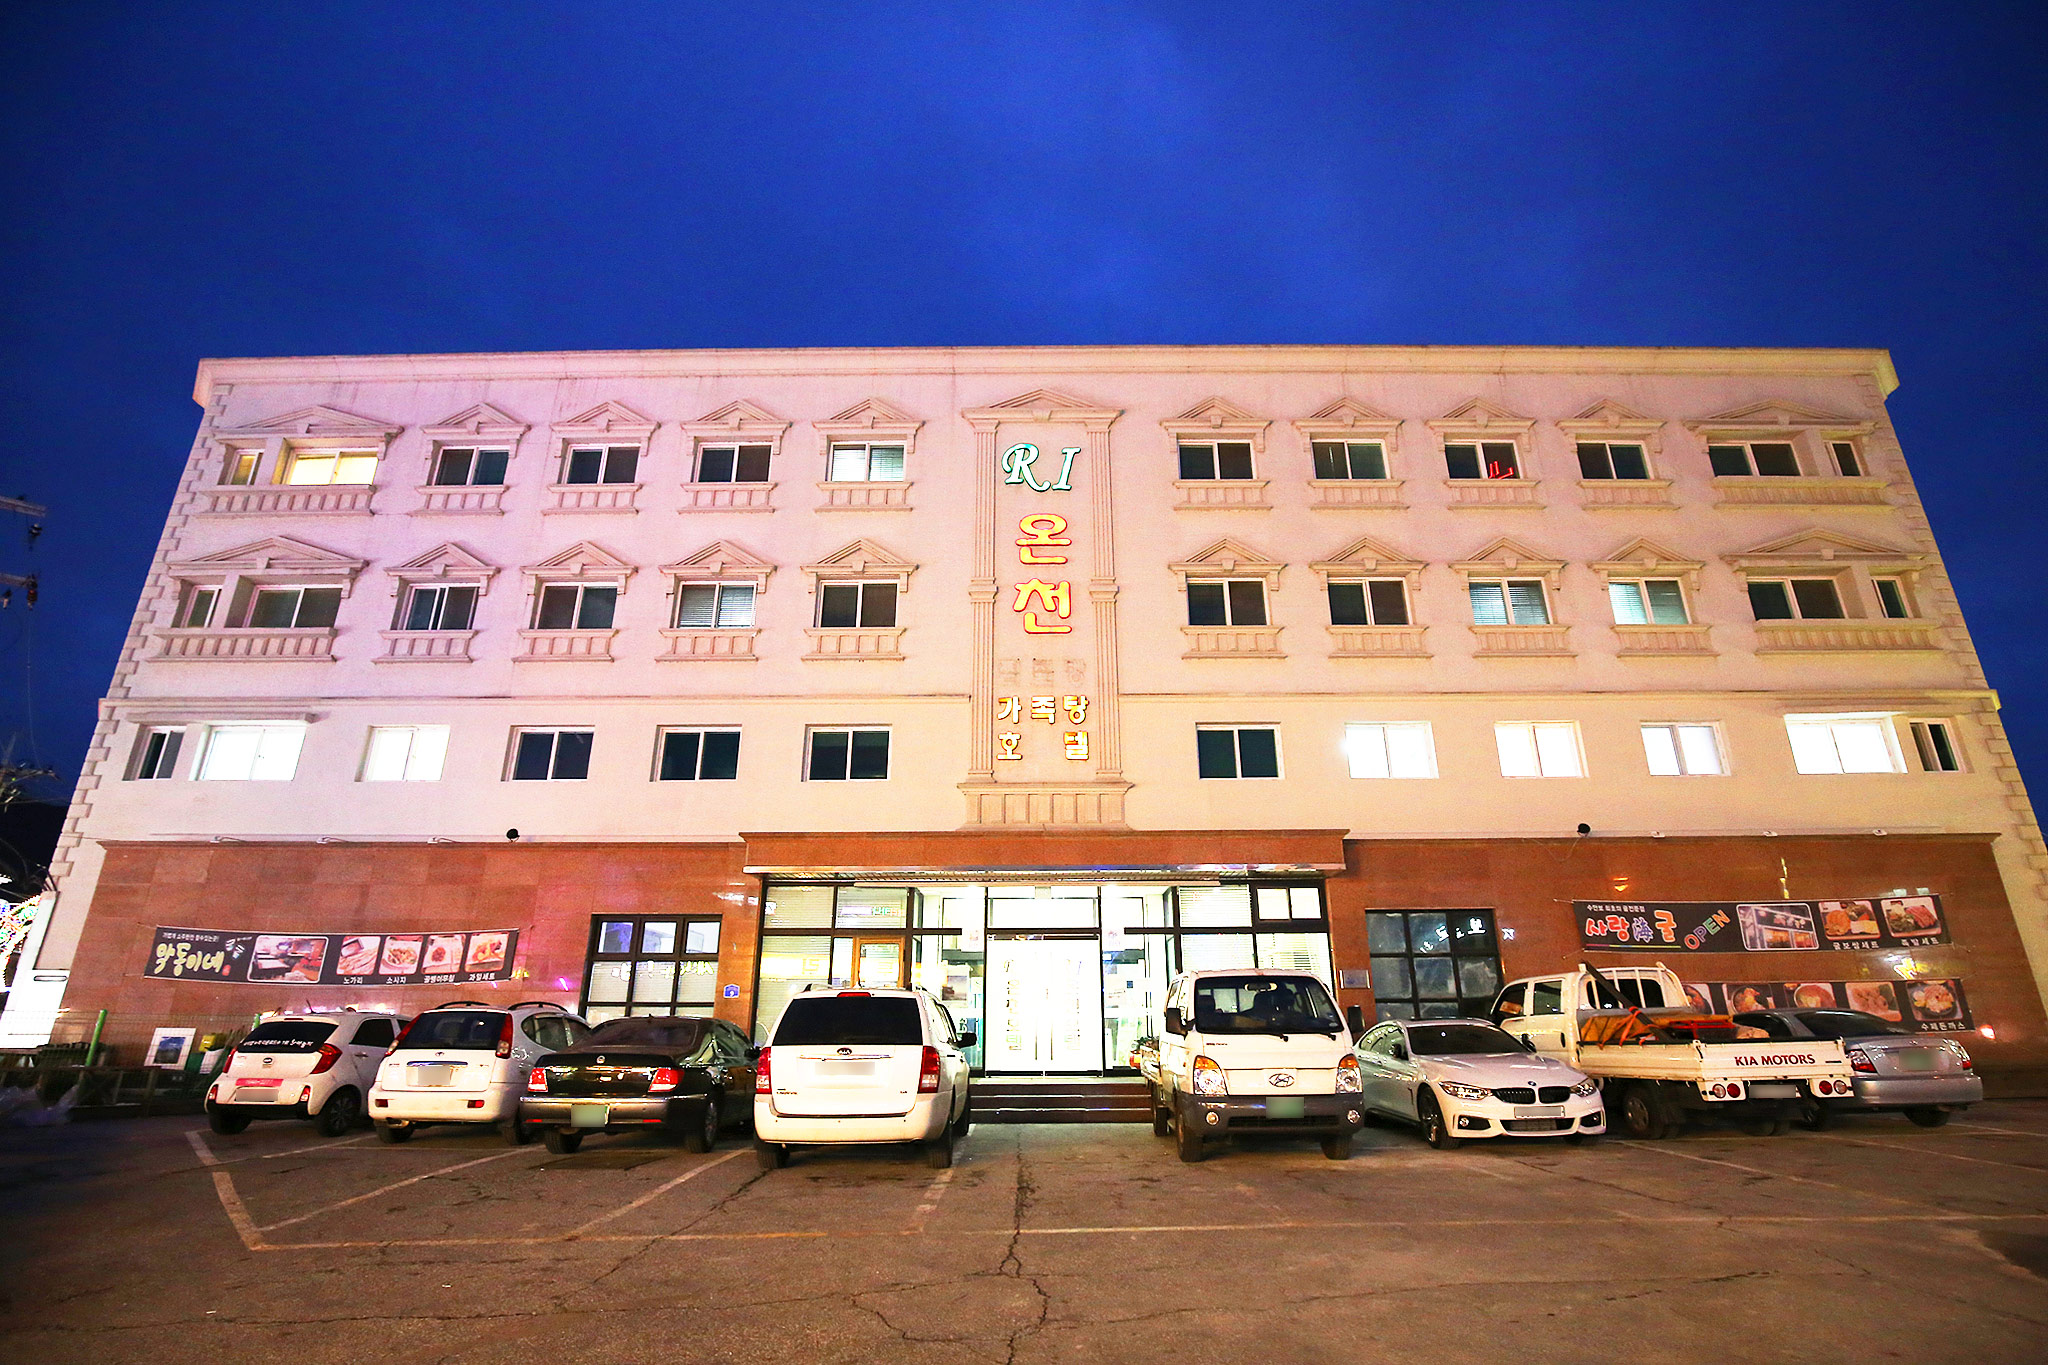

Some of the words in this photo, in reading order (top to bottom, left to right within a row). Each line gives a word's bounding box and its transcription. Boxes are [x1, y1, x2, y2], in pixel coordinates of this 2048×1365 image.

[1013, 513, 1073, 634] 온천
[997, 695, 1089, 725] 가족탕
[997, 731, 1089, 760] 호텔
[1684, 909, 1731, 950] OPEN
[343, 976, 364, 985] 노가리
[1734, 1056, 1758, 1066] KIA
[1761, 1054, 1816, 1066] MOTORS
